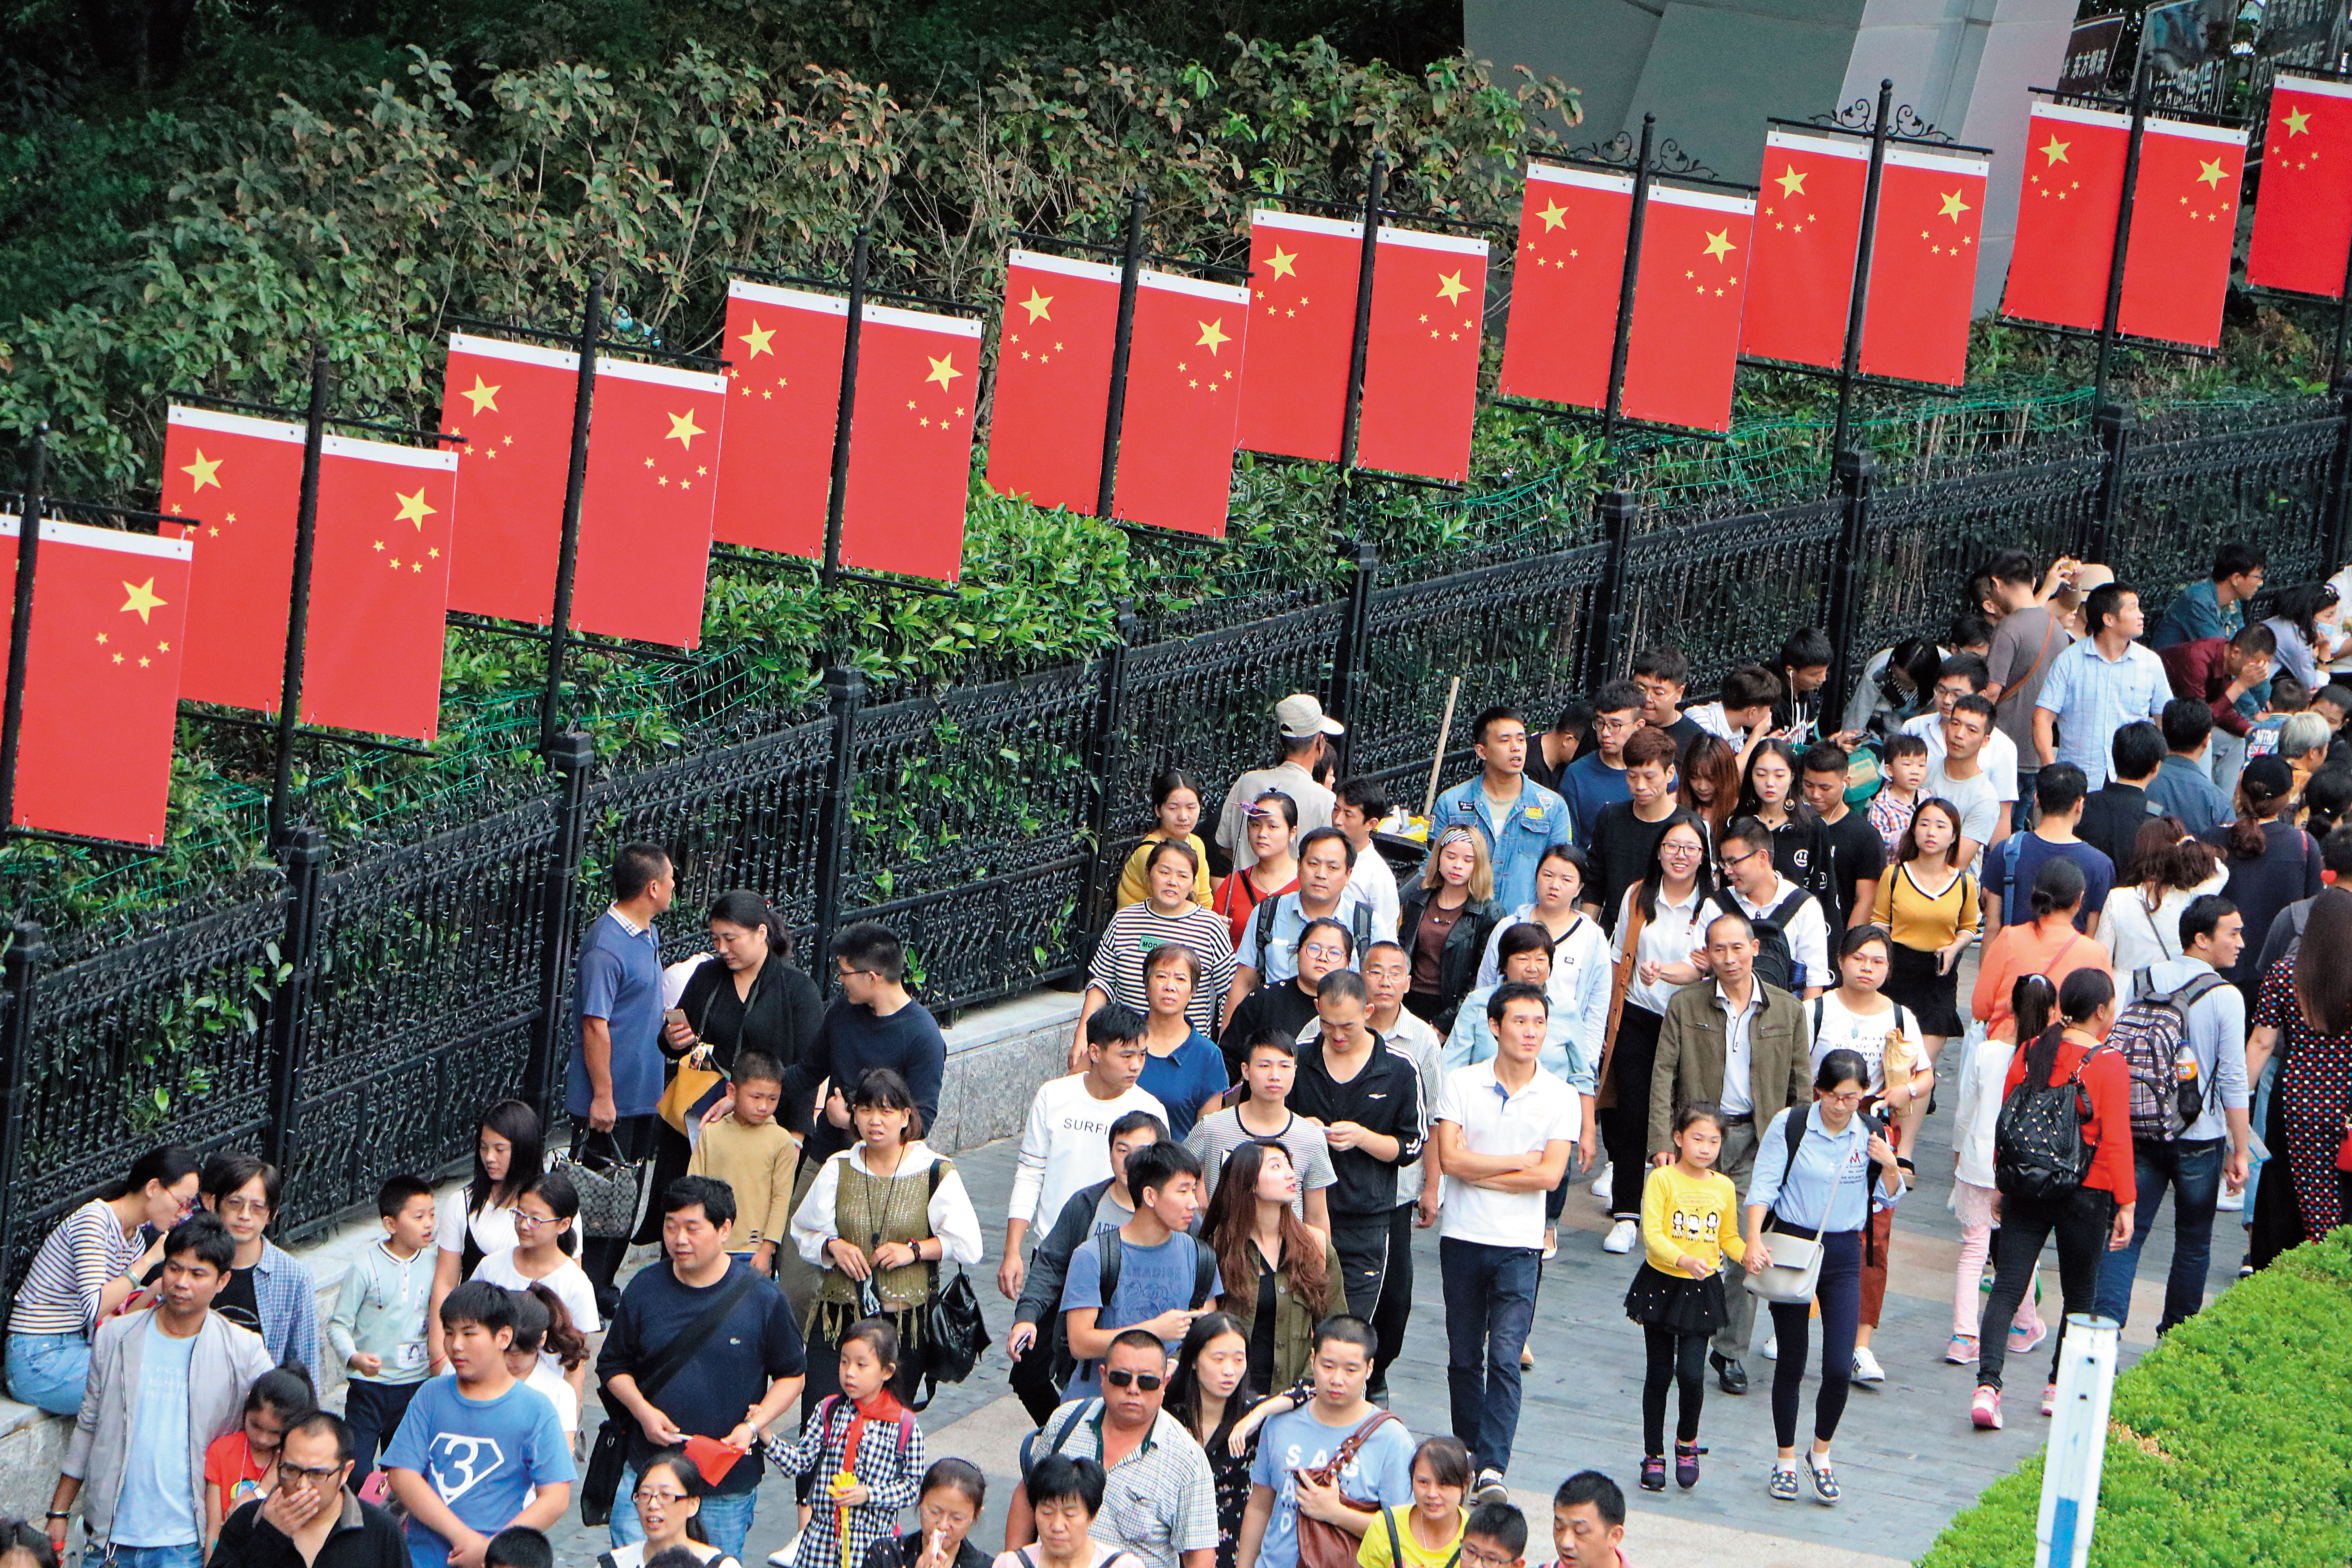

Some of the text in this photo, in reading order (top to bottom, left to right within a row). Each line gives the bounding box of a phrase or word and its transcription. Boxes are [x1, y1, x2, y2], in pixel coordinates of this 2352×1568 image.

[1063, 1118, 1107, 1135] SURFI
[1123, 1266, 1181, 1281] ARADISE
[438, 1436, 479, 1497] 3
